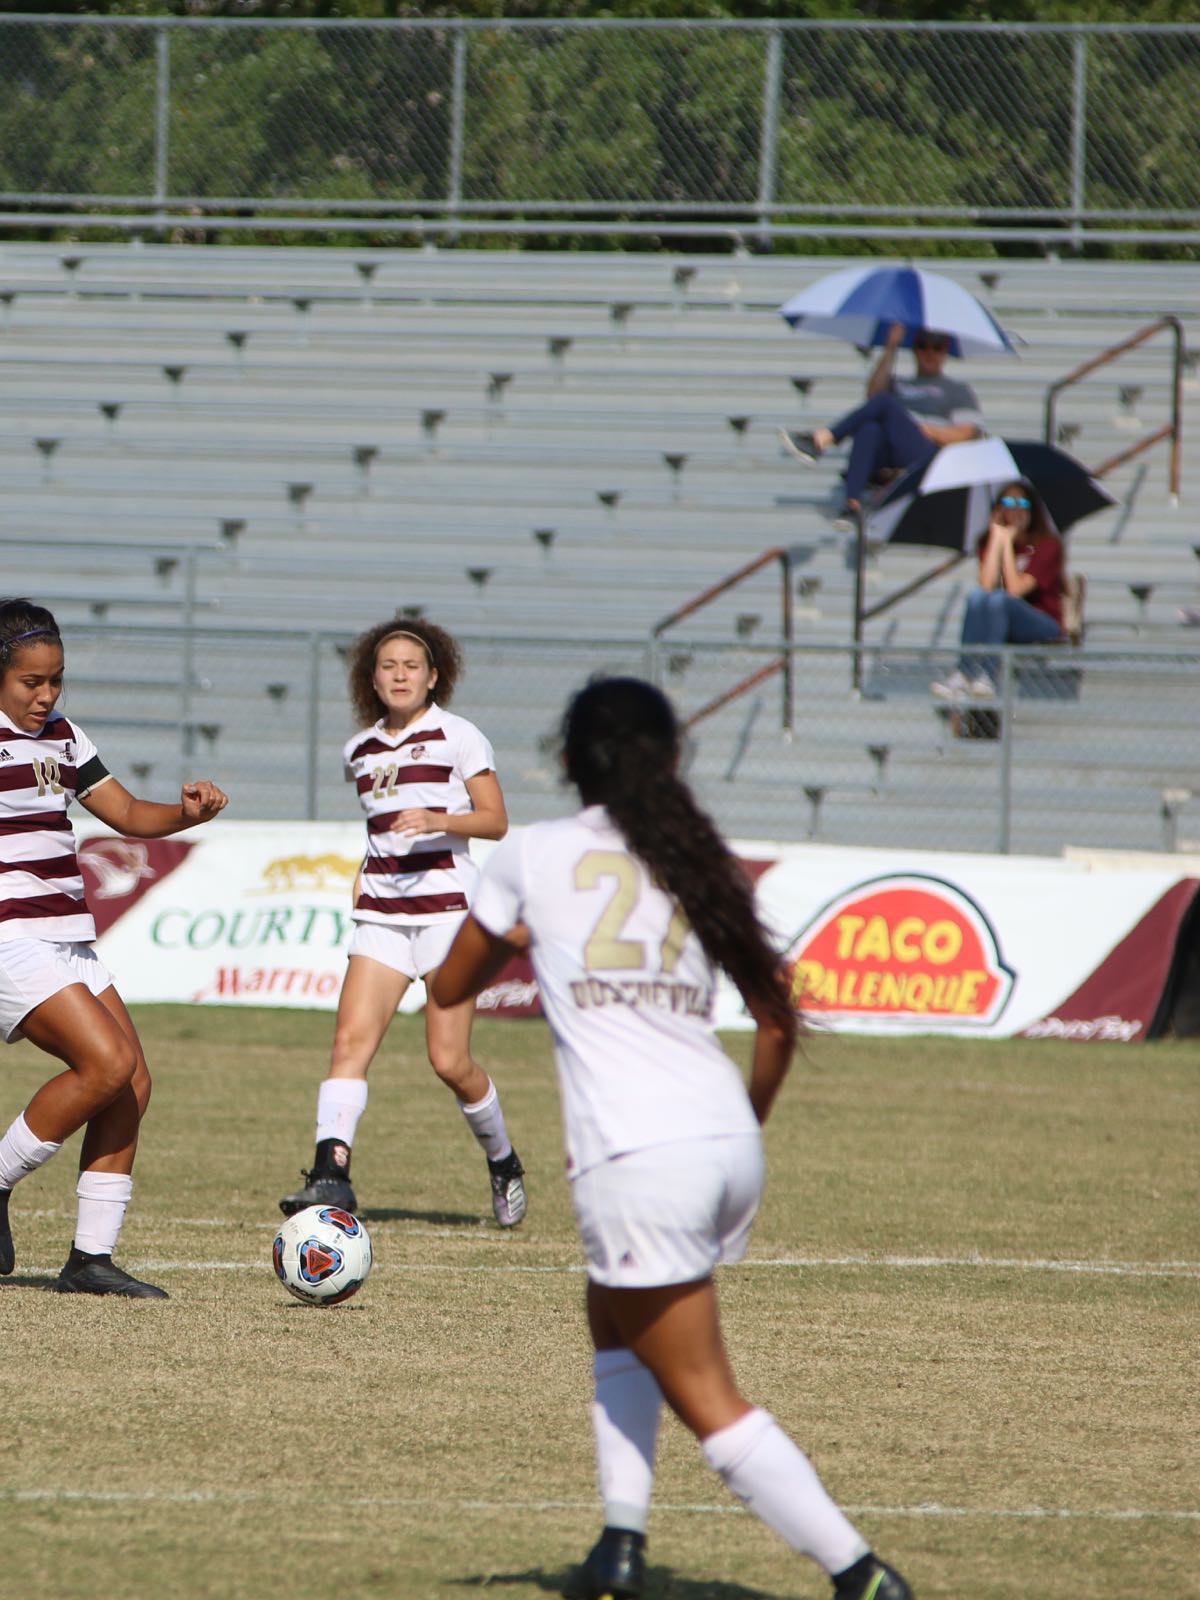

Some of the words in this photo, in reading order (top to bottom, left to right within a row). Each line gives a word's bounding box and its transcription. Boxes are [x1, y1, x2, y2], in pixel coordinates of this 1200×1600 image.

[370, 763, 399, 800] 22
[150, 904, 352, 949] COURTY
[836, 914, 963, 965] TACO
[193, 965, 340, 1001] Marrio
[791, 959, 988, 1015] PALENQUE
